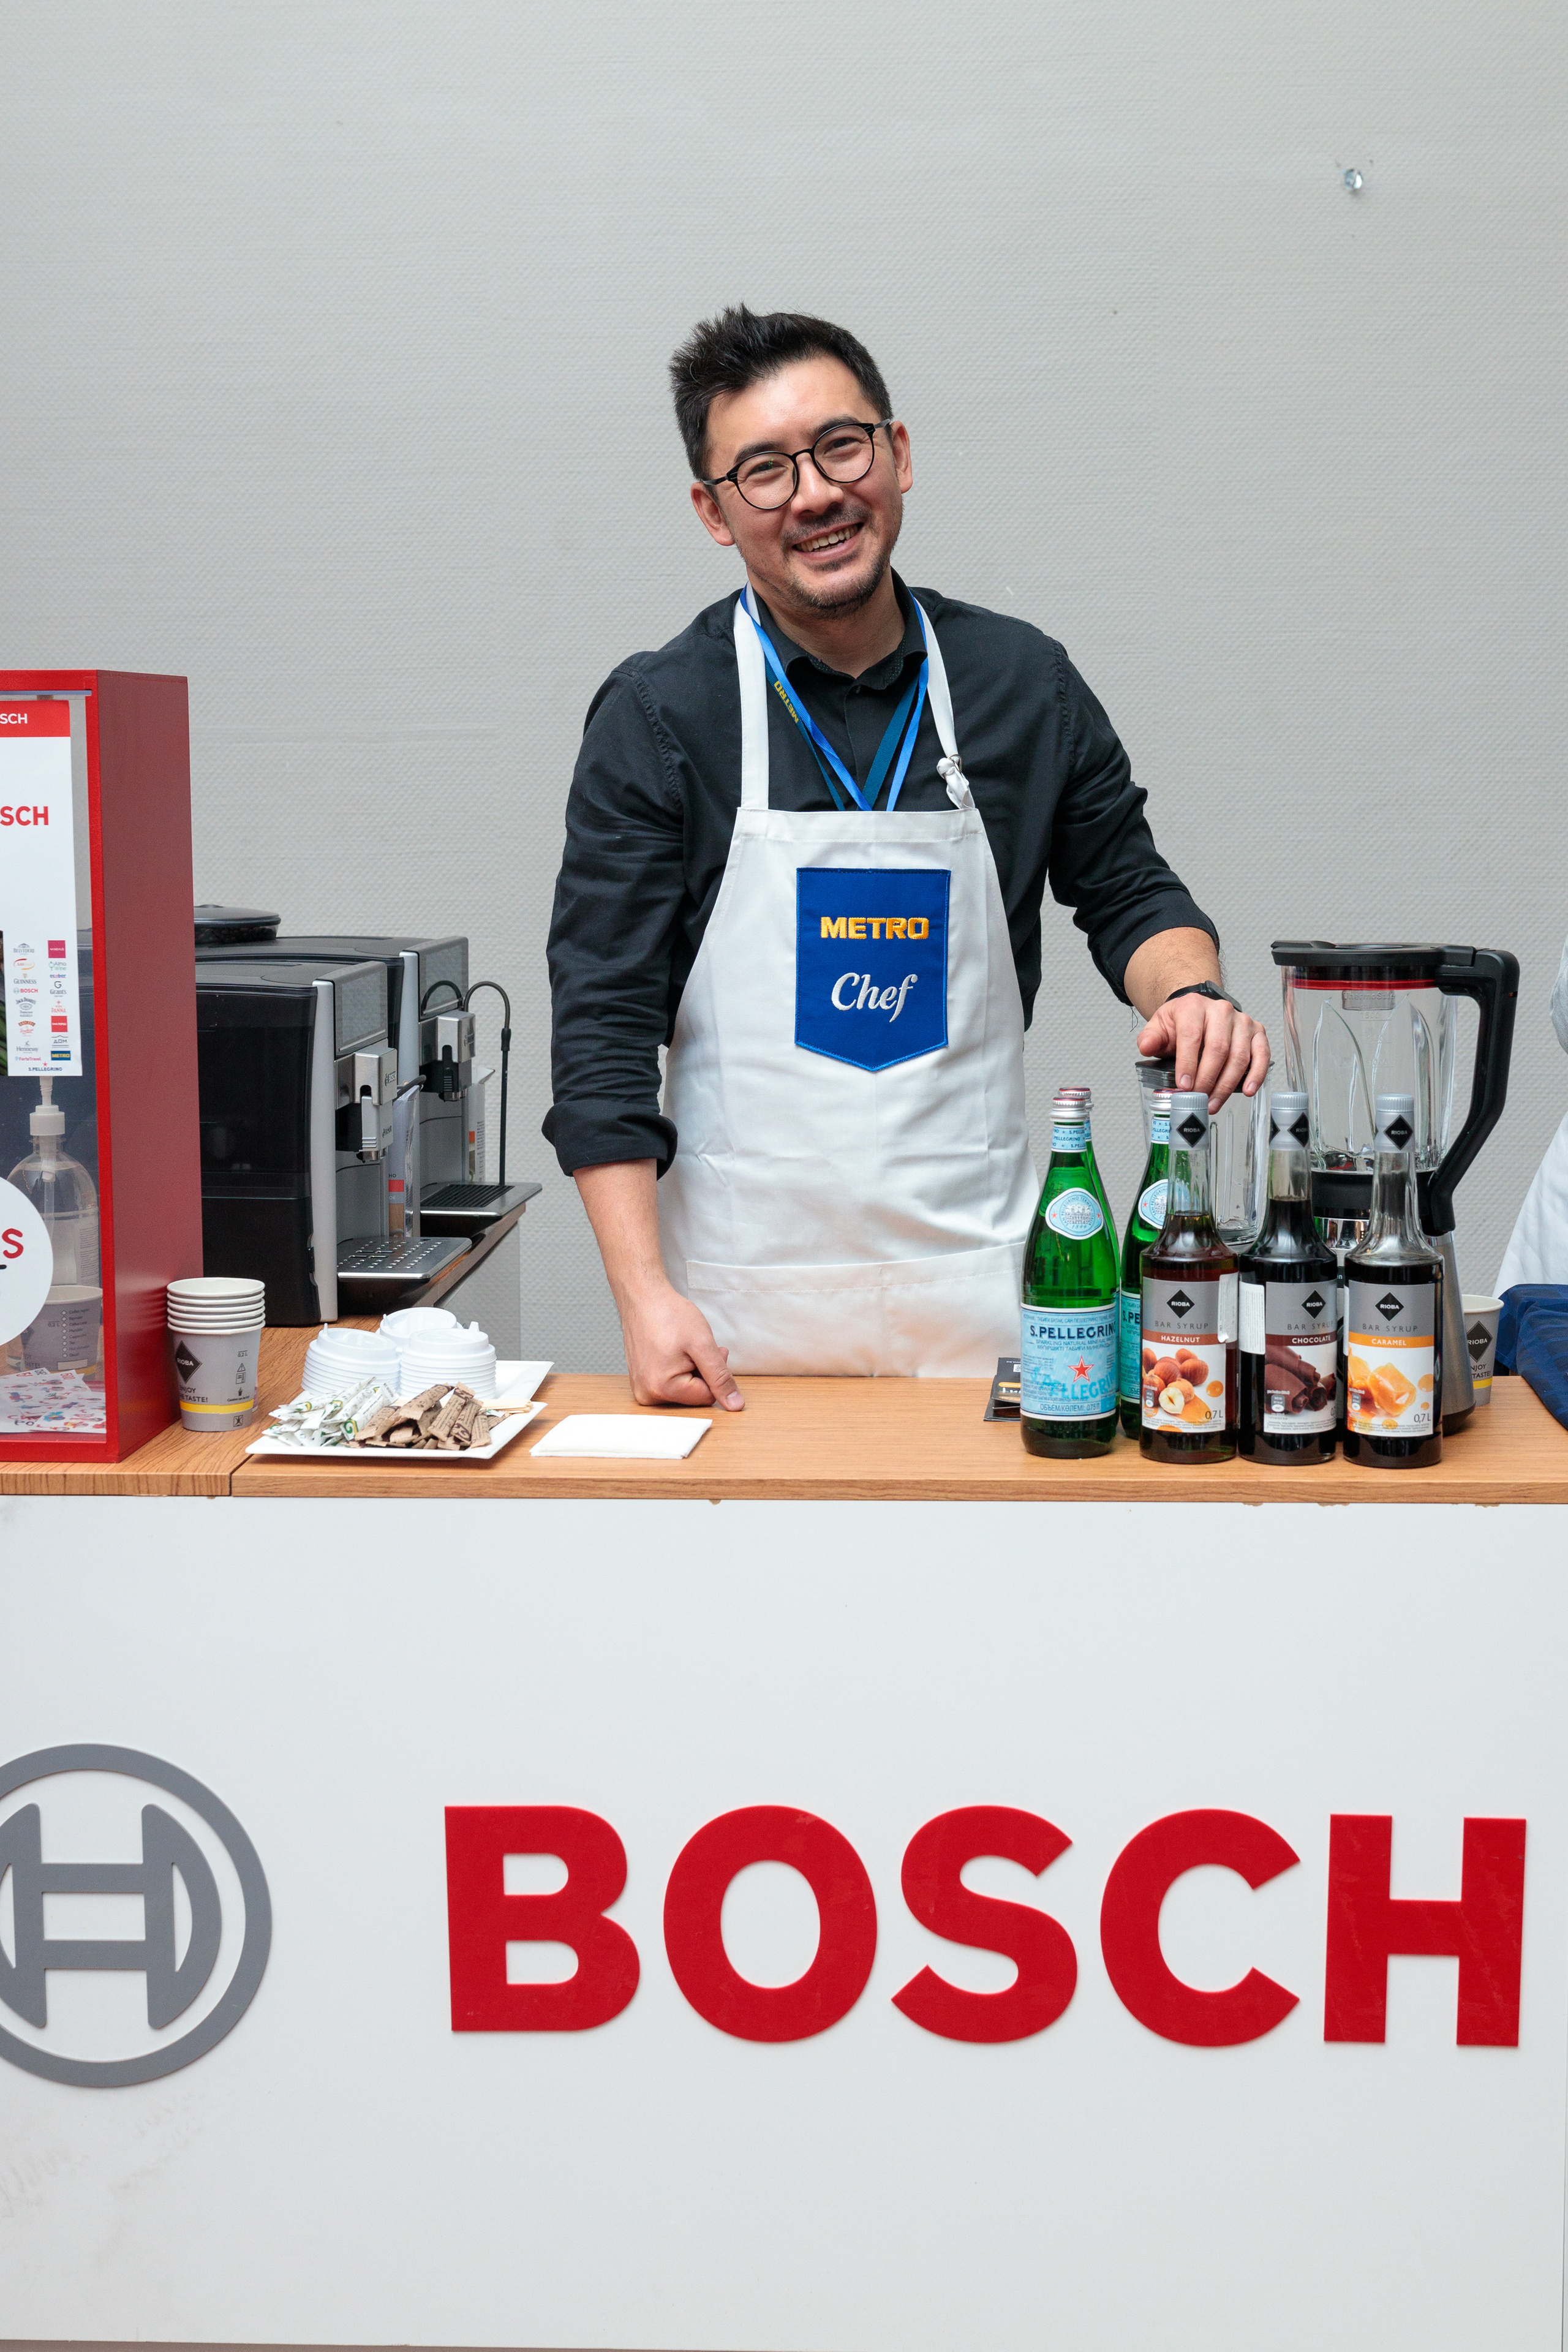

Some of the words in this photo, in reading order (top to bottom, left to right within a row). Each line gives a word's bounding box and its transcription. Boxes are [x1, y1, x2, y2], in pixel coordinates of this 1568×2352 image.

[774, 680, 799, 723] METRO
[821, 916, 930, 940] METRO
[831, 972, 918, 1022] Chef
[1292, 1335, 1331, 1344] CHOCOLATE
[1205, 1411, 1217, 1420] 0,7
[1414, 1414, 1425, 1423] 0,7
[444, 1804, 1527, 2049] BOSCH
